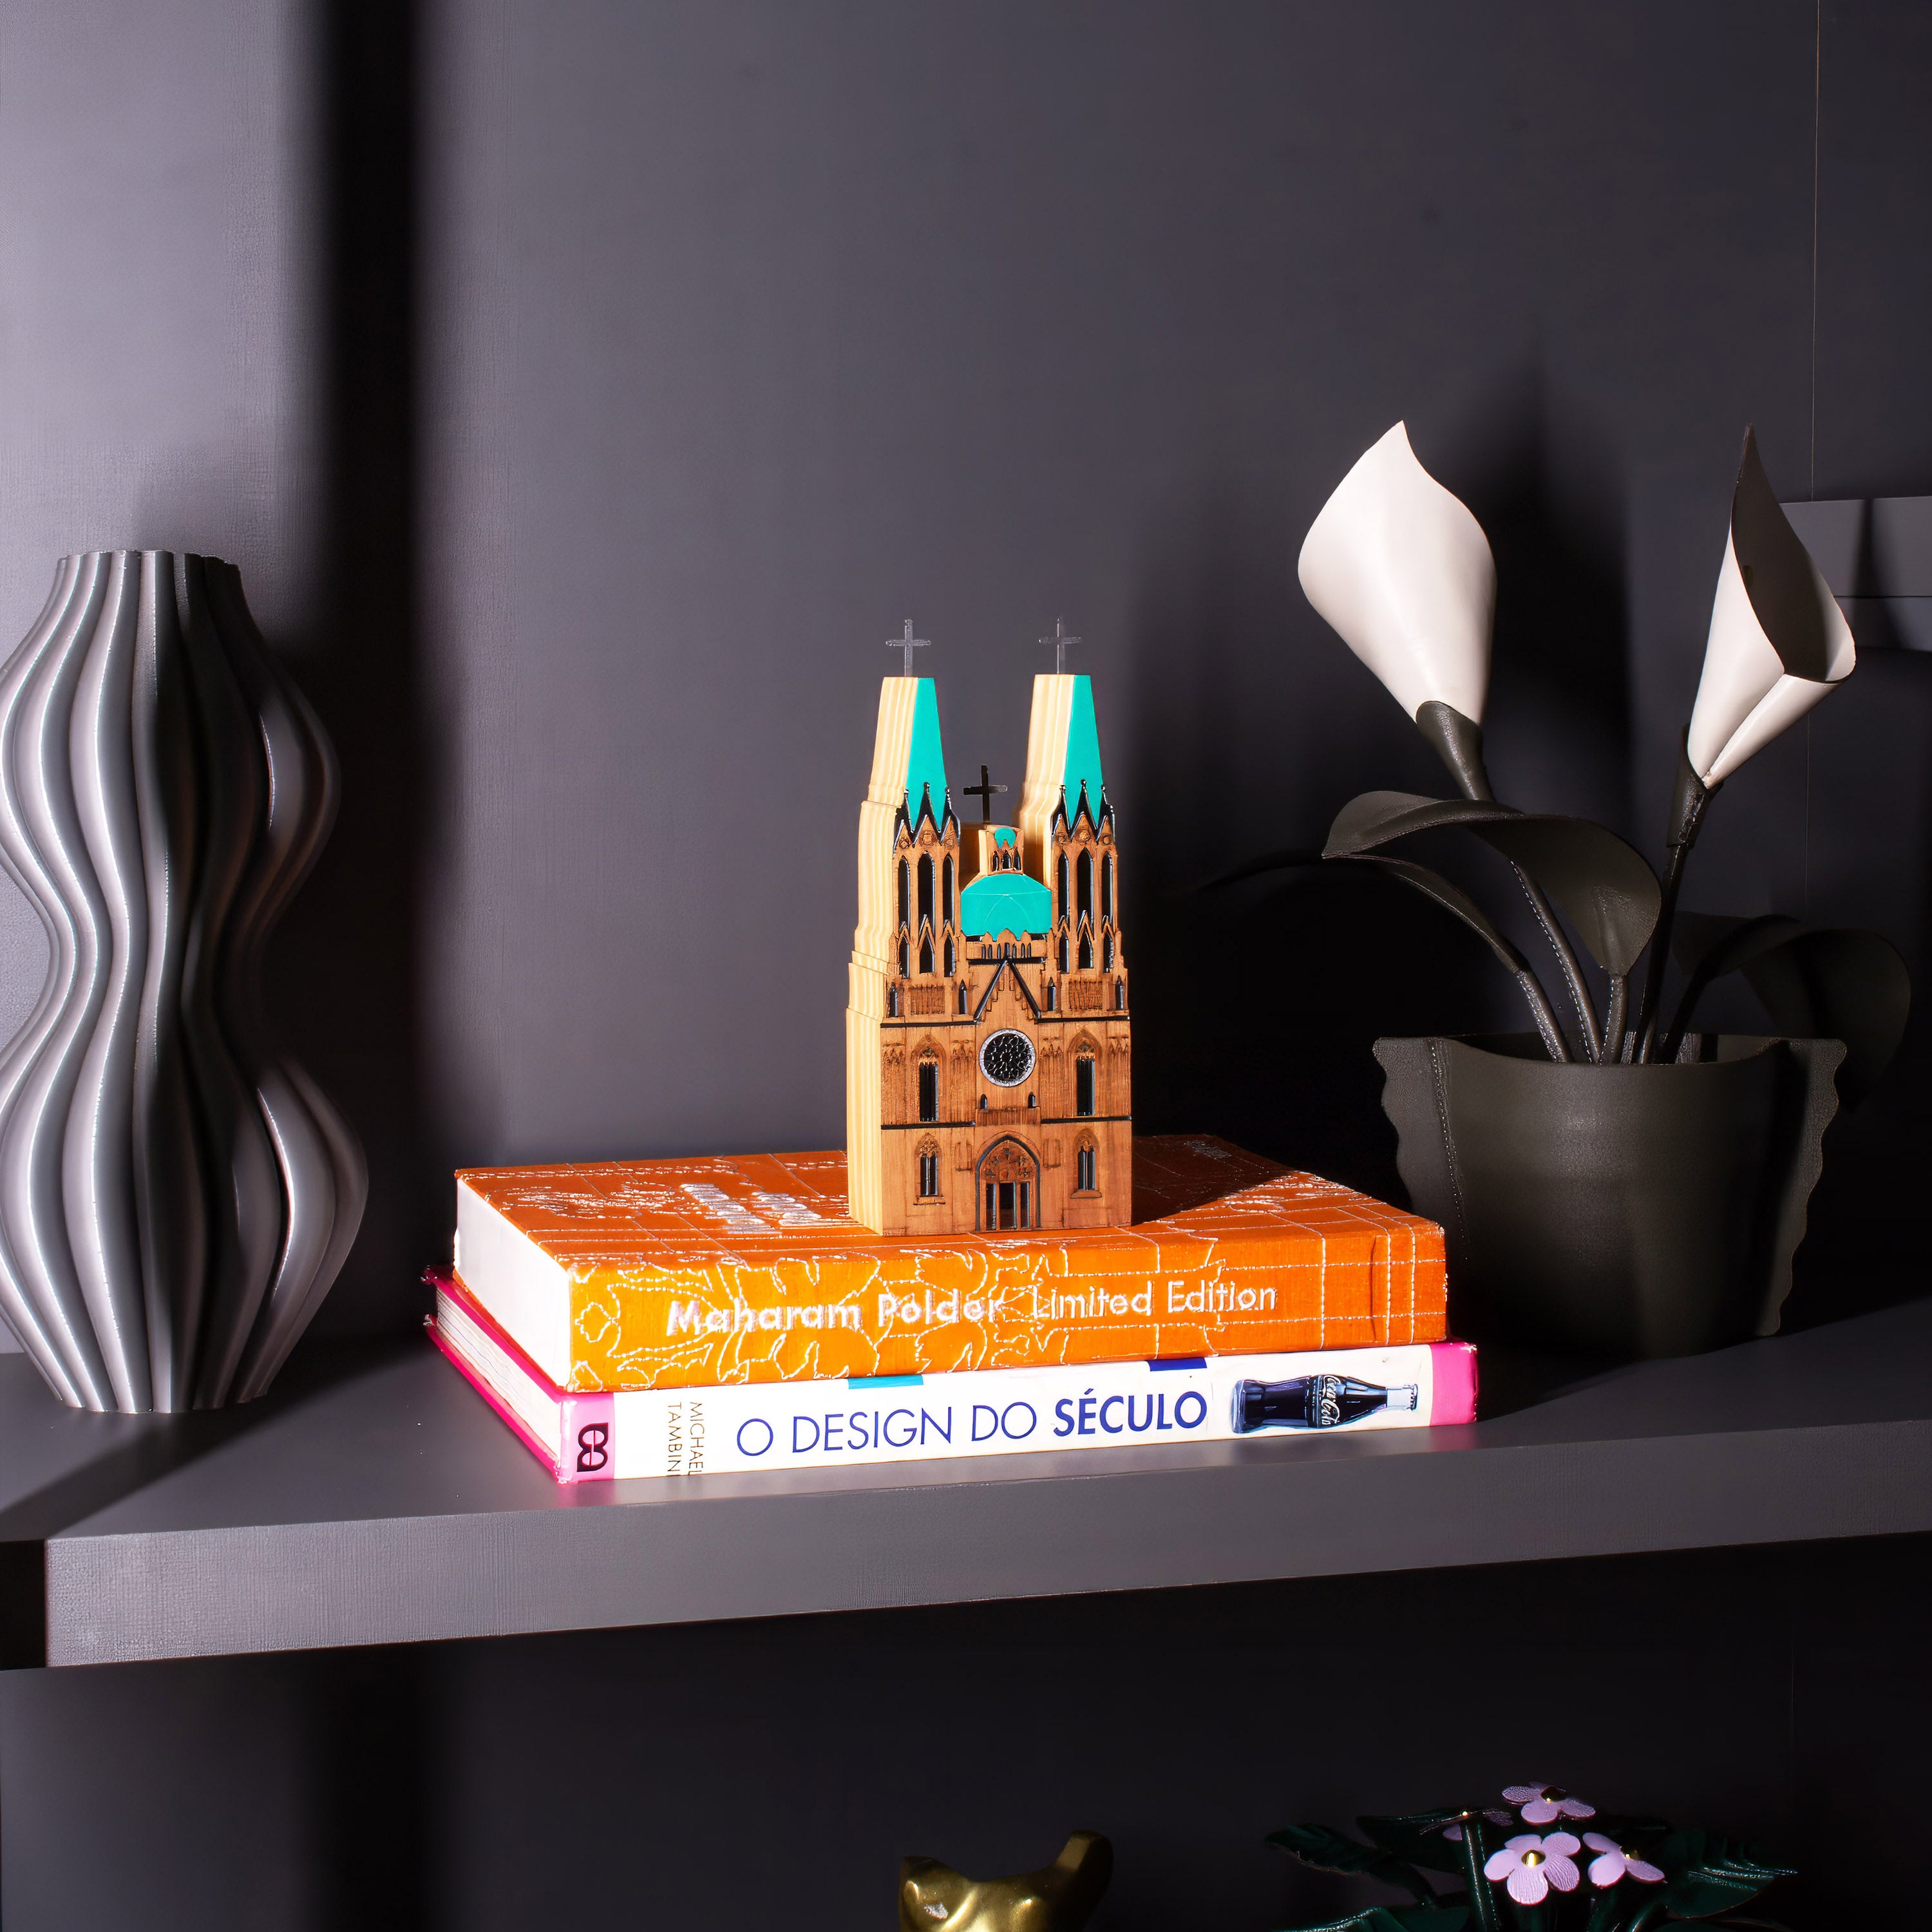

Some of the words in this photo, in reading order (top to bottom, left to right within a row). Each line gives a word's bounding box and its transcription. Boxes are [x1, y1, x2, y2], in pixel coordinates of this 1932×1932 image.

[667, 1298, 862, 1336] Maharam
[877, 1289, 996, 1327] Polder
[1032, 1280, 1153, 1320] Limited
[1167, 1279, 1278, 1314] Edition
[687, 1401, 705, 1476] MICHAEL
[737, 1418, 773, 1456] O
[792, 1406, 952, 1454] DESIGN
[971, 1401, 1037, 1442] DO
[1052, 1388, 1208, 1437] SÉCULO
